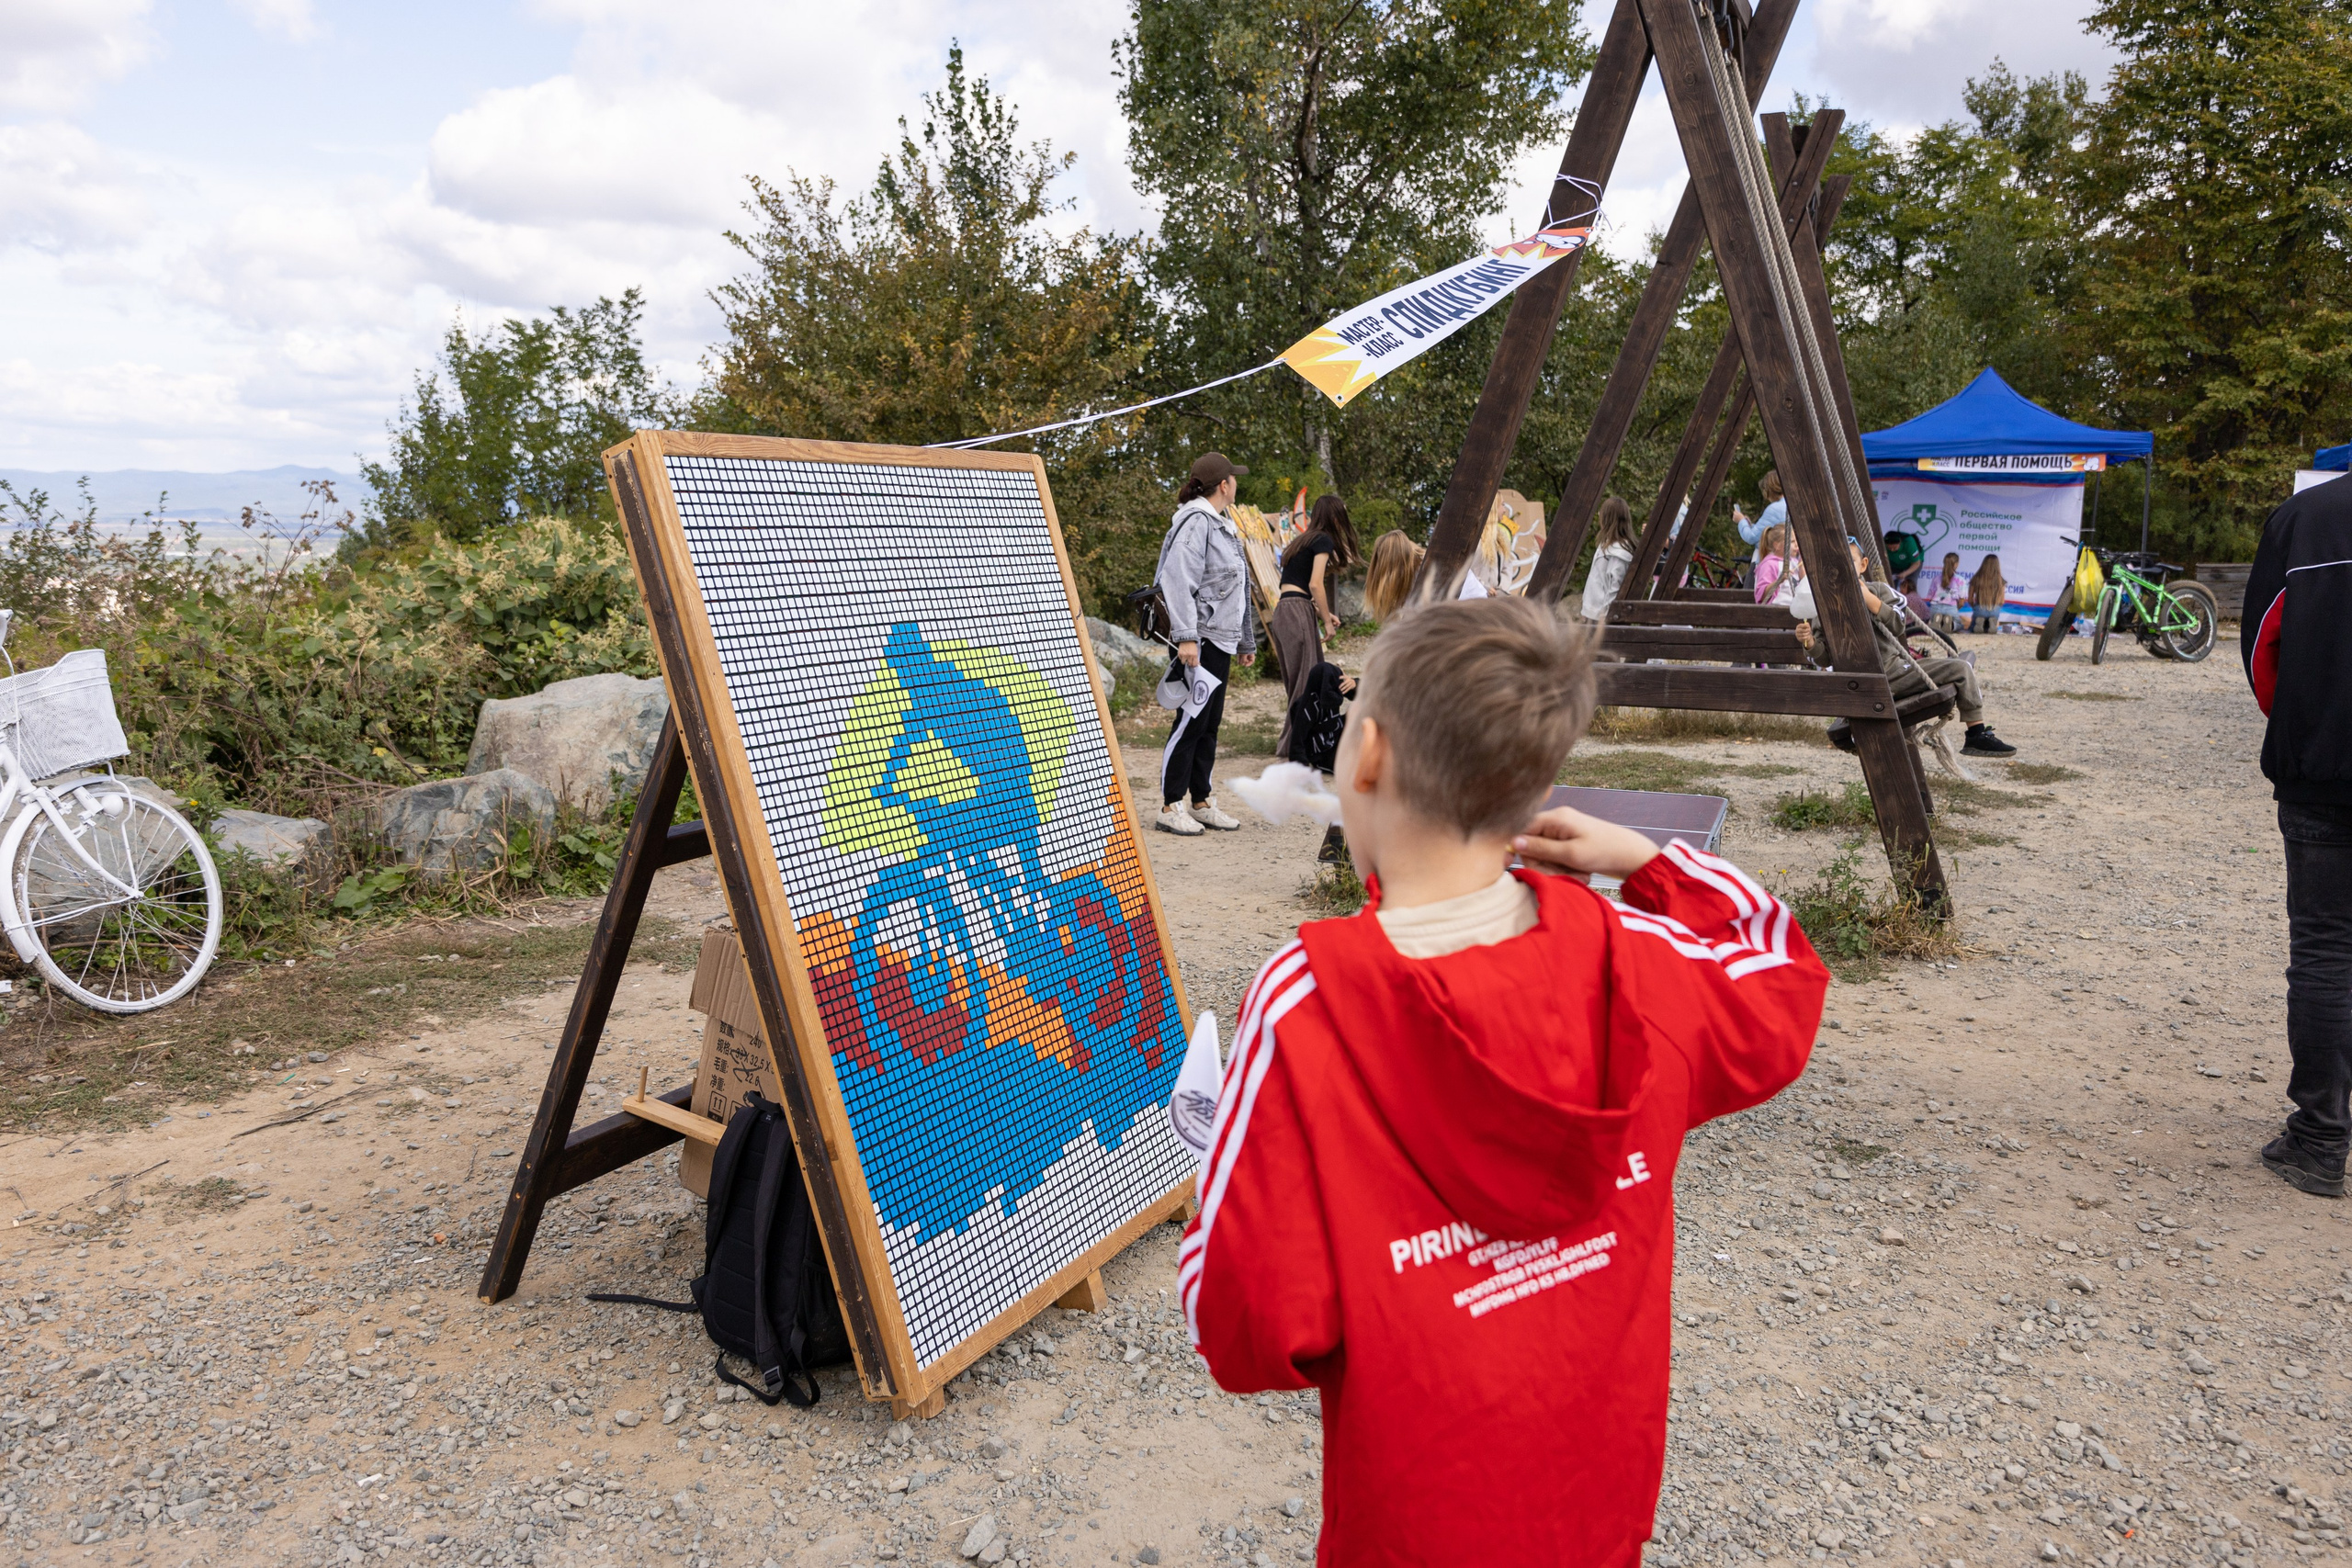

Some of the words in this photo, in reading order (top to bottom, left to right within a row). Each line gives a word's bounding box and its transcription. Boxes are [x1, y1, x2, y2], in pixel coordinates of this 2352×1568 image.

[1381, 259, 1531, 339] СПИДКУБИНГ
[1337, 316, 1385, 345] МАСТЕР-
[1955, 456, 2007, 468] ПЕРВАЯ
[2011, 455, 2073, 471] ПОМОЩЬ
[1961, 510, 2022, 522] Российское
[1960, 521, 2012, 531] общество
[1959, 533, 1998, 542] первой
[1958, 544, 2001, 553] помощи
